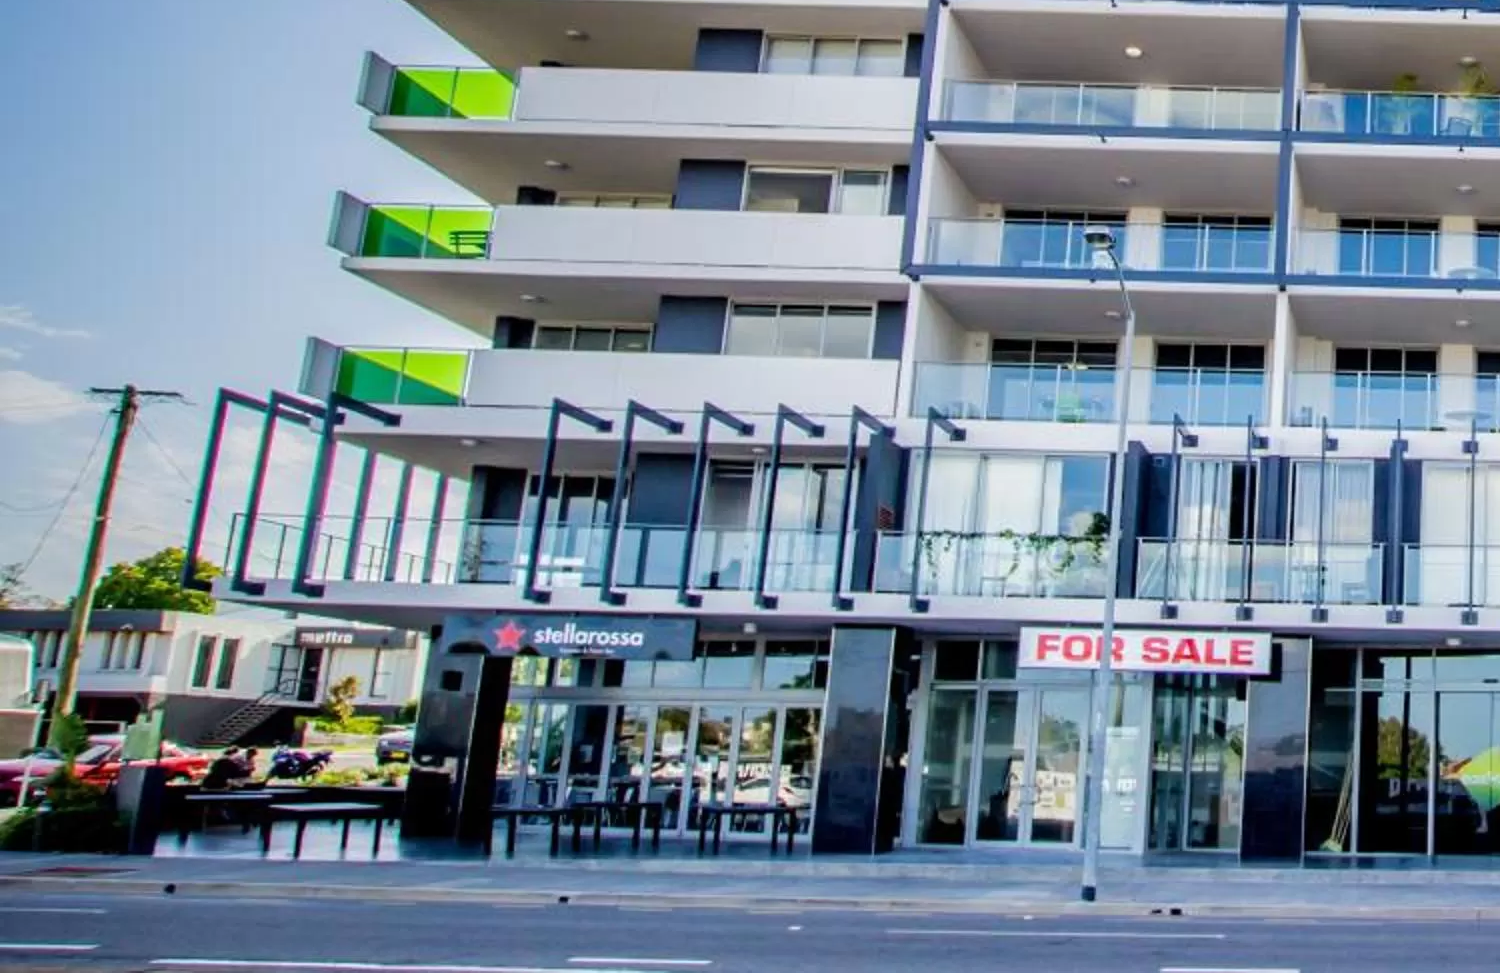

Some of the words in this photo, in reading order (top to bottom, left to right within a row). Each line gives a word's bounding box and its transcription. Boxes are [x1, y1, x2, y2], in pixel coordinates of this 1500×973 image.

[534, 622, 644, 647] stellarossa
[1036, 634, 1125, 662] FOR
[1142, 636, 1255, 666] SALE
